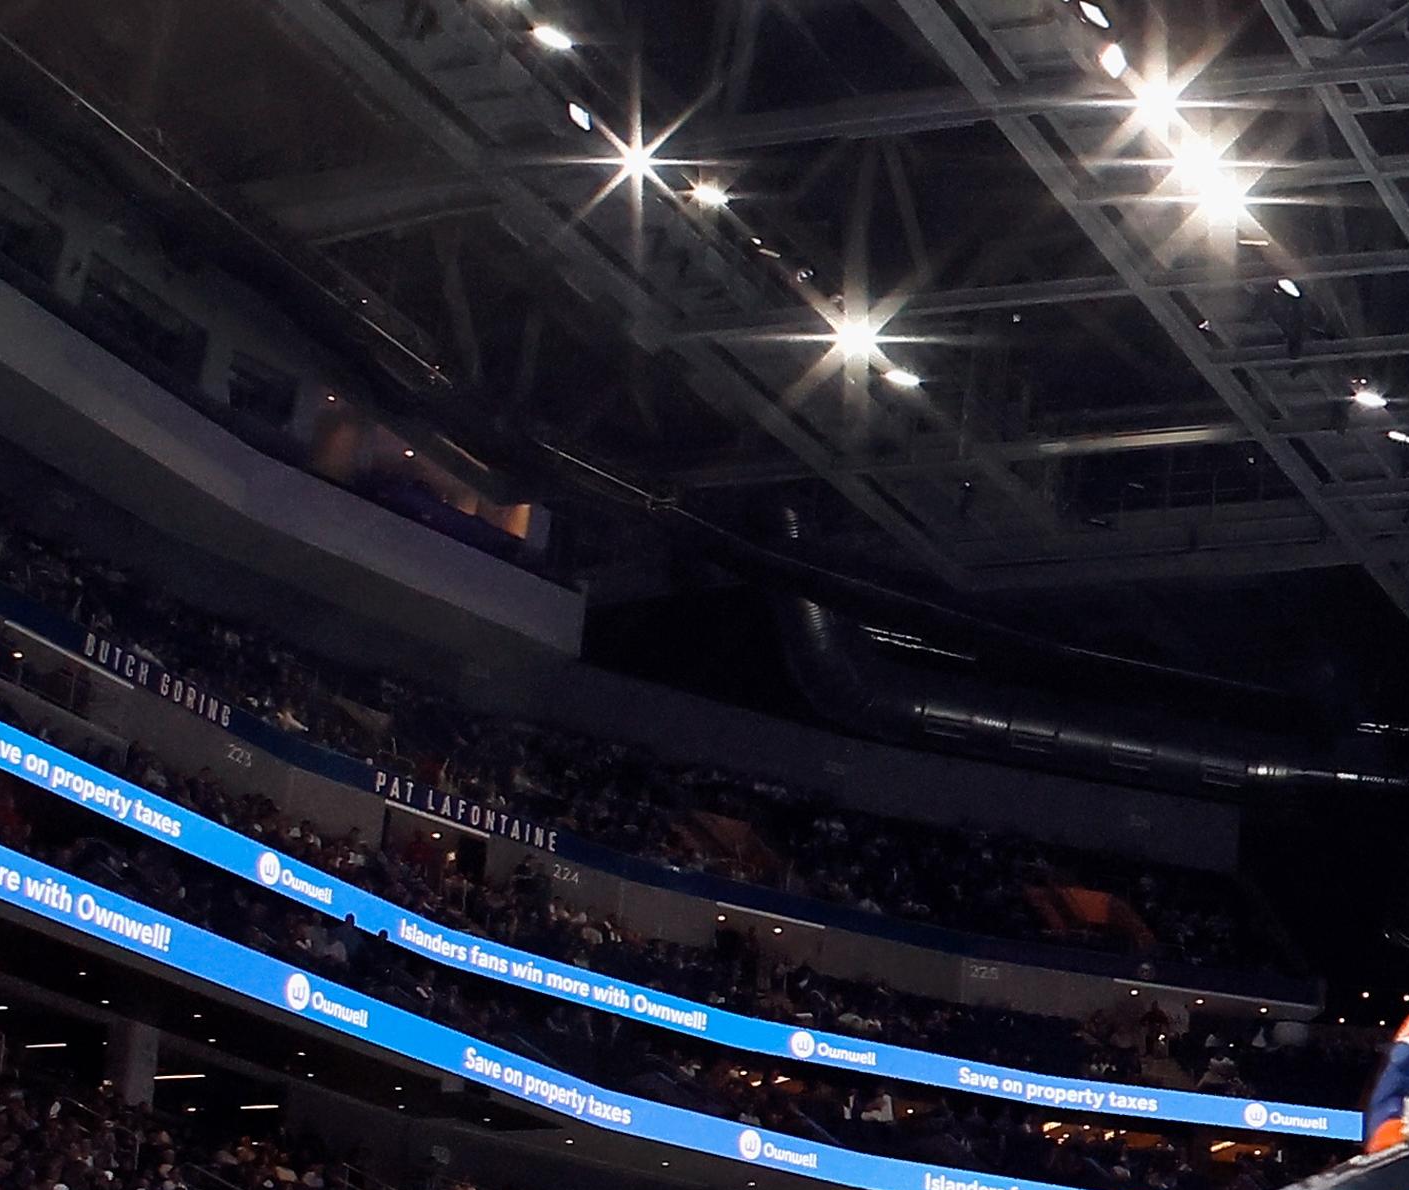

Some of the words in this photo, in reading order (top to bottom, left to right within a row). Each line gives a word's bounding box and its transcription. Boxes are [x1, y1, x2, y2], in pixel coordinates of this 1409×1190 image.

[159, 673, 232, 728] GORING
[26, 754, 51, 777] on
[52, 766, 133, 819] property
[133, 798, 182, 838] taxes
[374, 770, 416, 804] PAT
[426, 789, 559, 853] LAFONTAINE
[26, 863, 73, 914] with
[77, 894, 173, 953] Ownwell!
[280, 869, 333, 904] Ownwell
[399, 917, 468, 961] Islanders
[470, 946, 509, 974] fans
[511, 958, 544, 985] win
[545, 970, 590, 998] more
[592, 976, 631, 1009] with
[632, 992, 708, 1032] Ownwell!
[312, 992, 369, 1029] Ownwell
[816, 1041, 877, 1067] Ownwell
[463, 1047, 502, 1082] Save
[503, 1067, 524, 1087] on
[524, 1069, 588, 1113] property
[587, 1094, 633, 1125] taxes
[958, 1065, 998, 1088] Save
[1002, 1075, 1024, 1093] on
[1025, 1080, 1104, 1110] property
[1106, 1086, 1159, 1113] taxes
[1269, 1110, 1328, 1134] Ownwell
[763, 1142, 818, 1171] Ownwell
